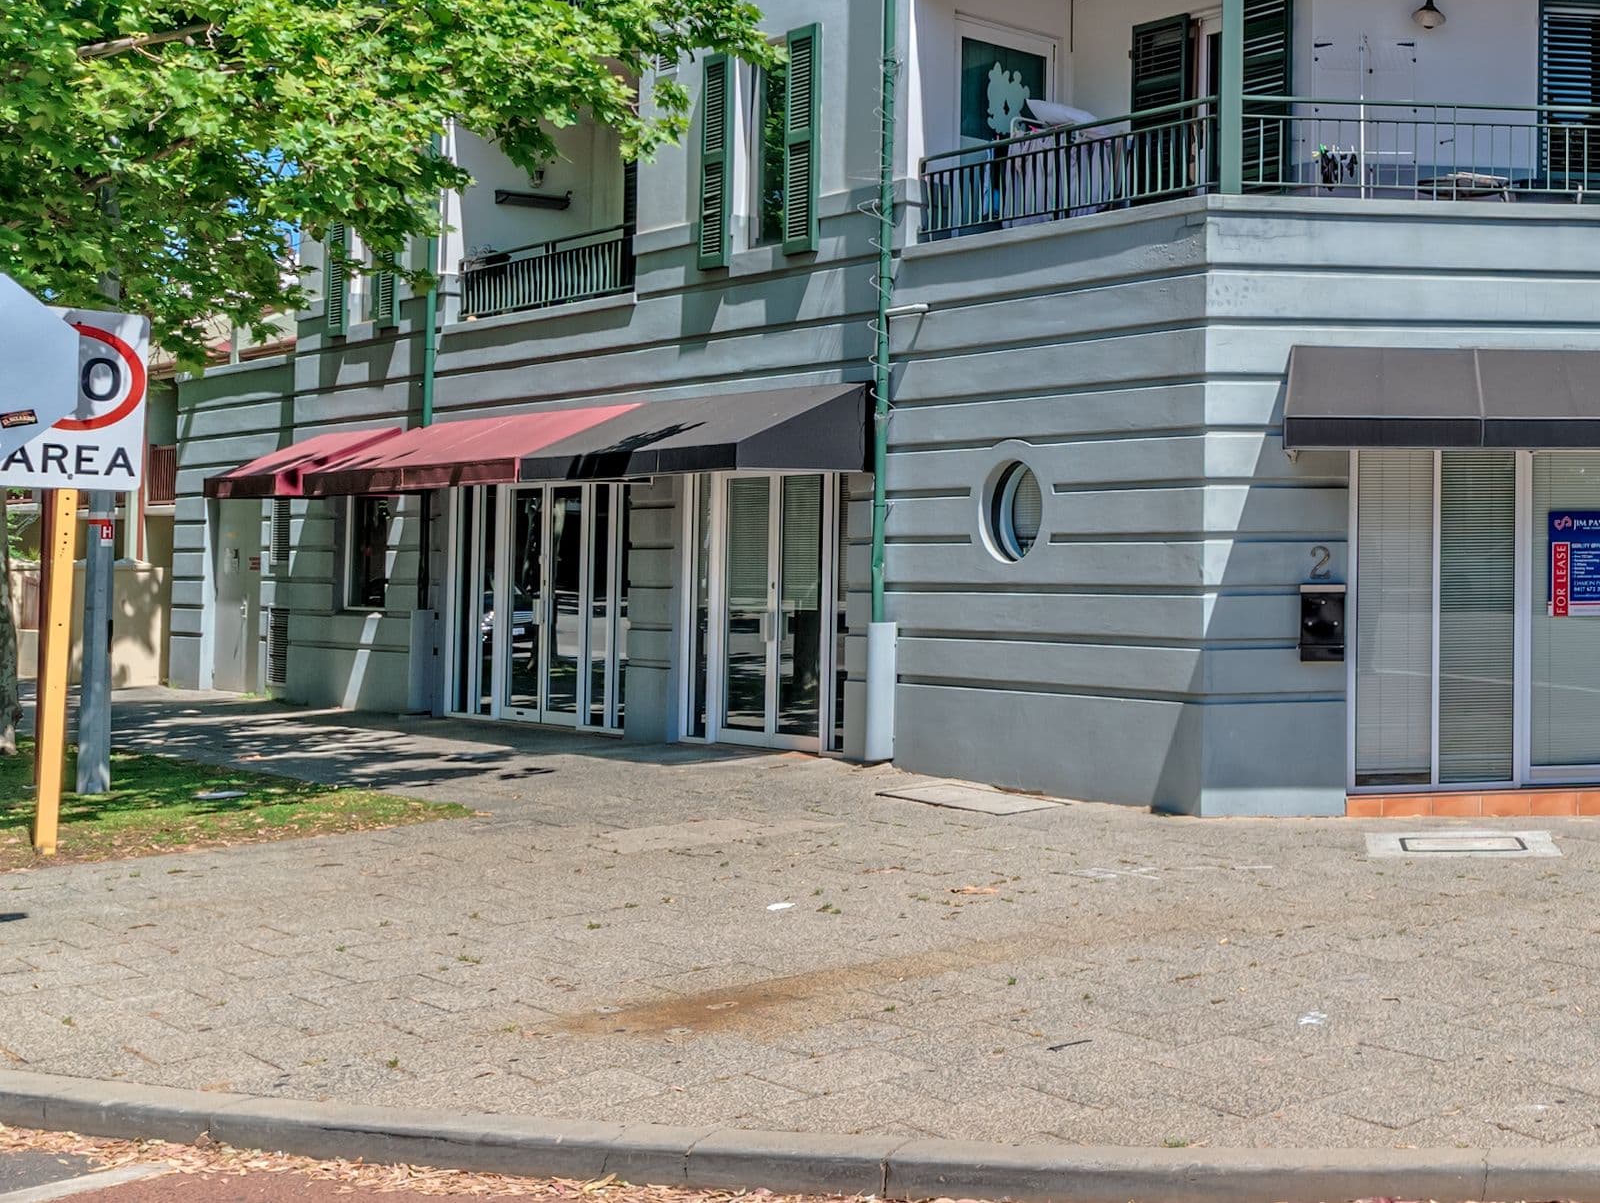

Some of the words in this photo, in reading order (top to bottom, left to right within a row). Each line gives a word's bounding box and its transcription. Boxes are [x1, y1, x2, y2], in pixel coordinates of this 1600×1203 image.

[0, 442, 136, 477] AREA
[102, 525, 112, 538] H
[1573, 519, 1587, 531] JIM
[1309, 545, 1331, 580] 2
[1556, 545, 1567, 583] LEASE
[1556, 588, 1567, 614] FOR
